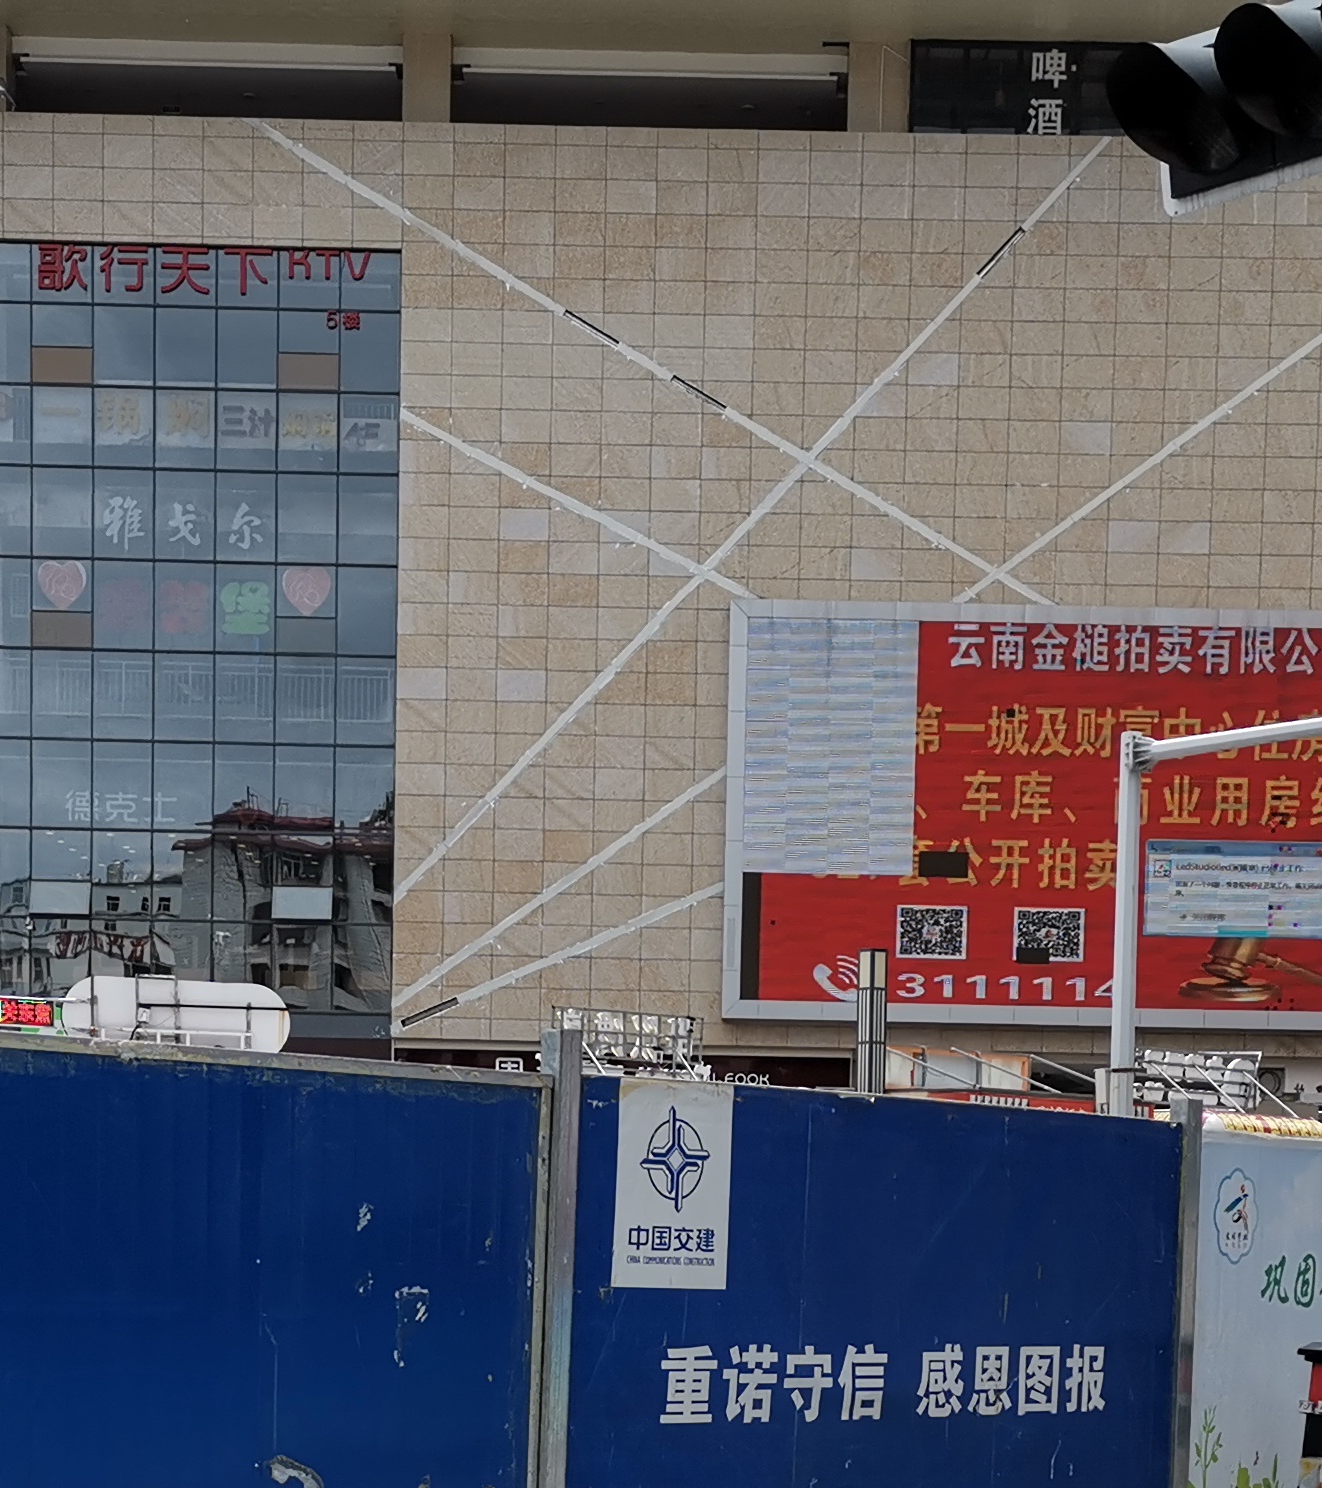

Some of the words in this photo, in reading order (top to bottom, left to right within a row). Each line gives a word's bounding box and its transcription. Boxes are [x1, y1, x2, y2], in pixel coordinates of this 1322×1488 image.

[1027, 48, 1068, 134] 啤酒
[37, 244, 274, 295] 歌行天下
[287, 249, 372, 280] KTV
[326, 311, 361, 331] 5楼
[103, 496, 264, 550] 雅戈尔
[64, 790, 176, 823] 德克士
[628, 1226, 715, 1253] 中国交建
[659, 1344, 888, 1425] 重诺守信
[916, 1343, 1106, 1419] 感恩图报
